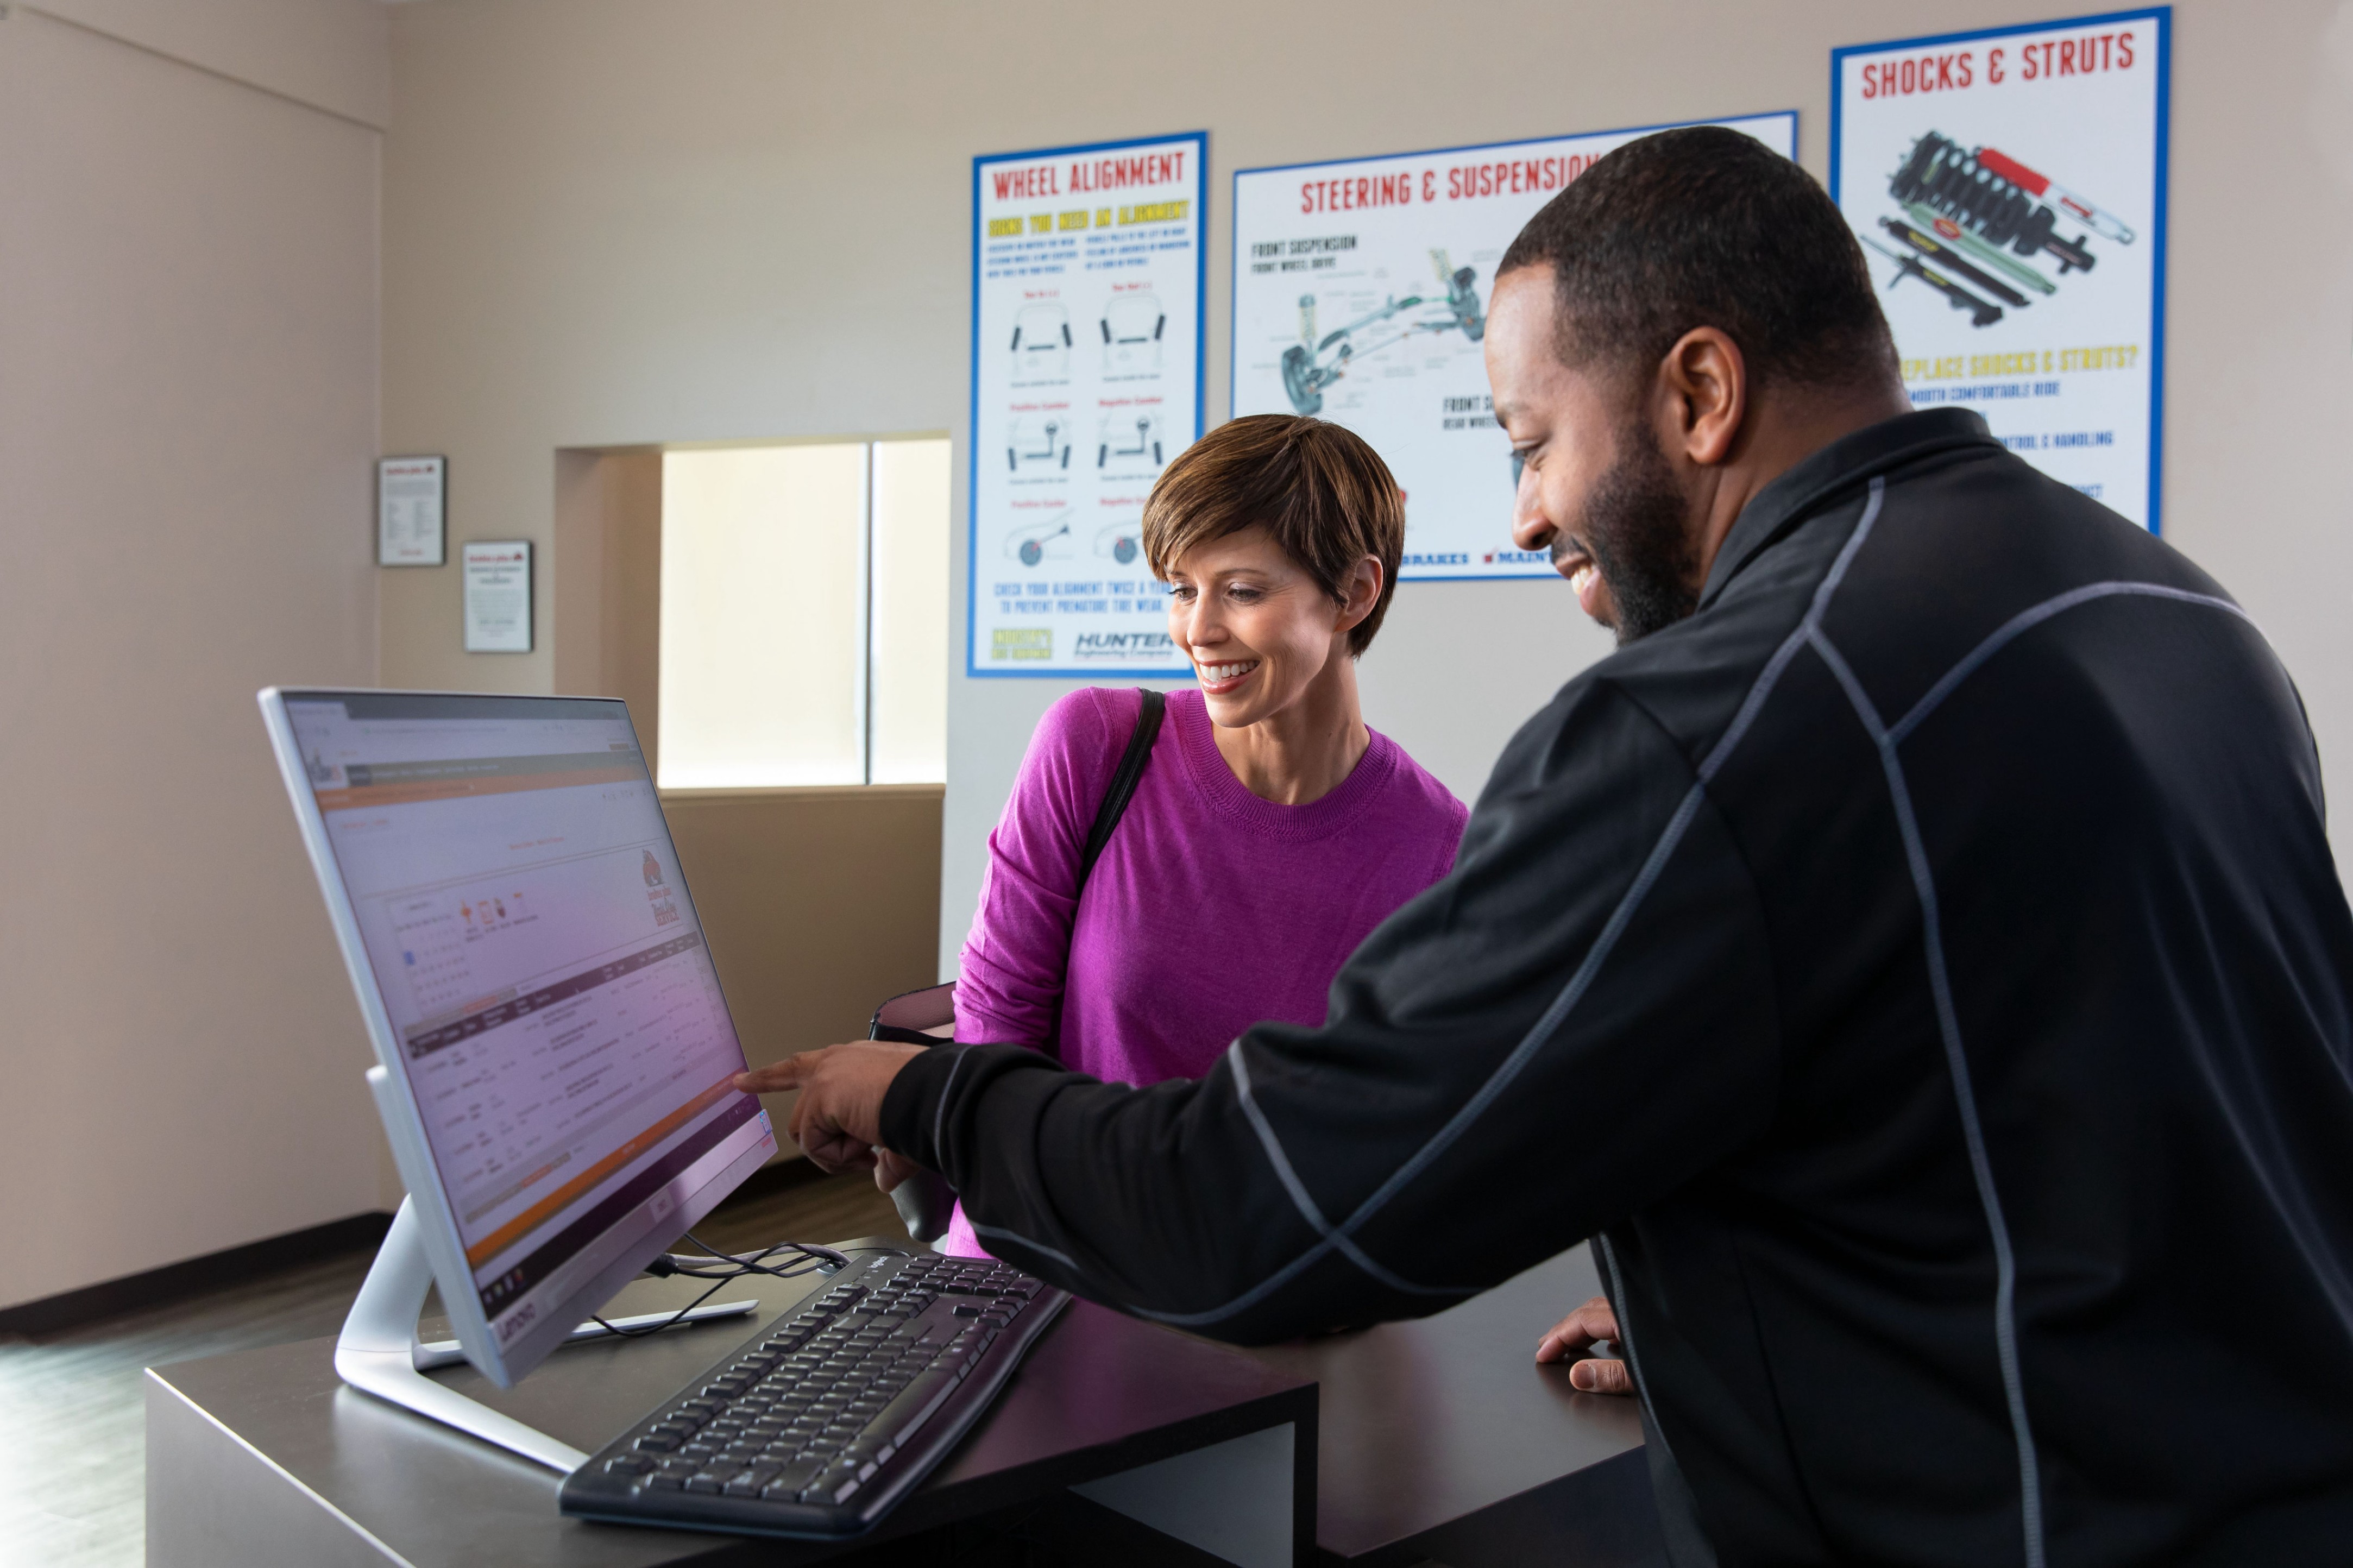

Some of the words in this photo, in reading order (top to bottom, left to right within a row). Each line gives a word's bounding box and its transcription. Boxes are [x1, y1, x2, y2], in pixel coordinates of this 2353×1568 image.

[1863, 53, 1973, 99] SHOCKS
[2022, 32, 2134, 80] STRUTS
[993, 166, 1059, 201] WHEEL
[1069, 152, 1185, 193] ALIGNMENT
[1301, 173, 1411, 213] STEERING
[1449, 154, 1599, 199] SUSPENSIO
[1118, 200, 1189, 226] ALIGNMENT
[1252, 241, 1285, 257] FRONT
[1289, 236, 1357, 255] SUSPENSION
[1901, 355, 1963, 382] EPLACE
[1971, 353, 2036, 376] SHOCKS
[2060, 345, 2138, 371] STRUTS?
[1444, 396, 1480, 412] FRONT
[1908, 386, 1946, 403] MOOTH
[1950, 383, 2030, 401] COMFORTABLE
[2033, 381, 2060, 396] RIDE
[2053, 432, 2113, 448] HANDLING
[1052, 582, 1103, 596] ALIGNMENT
